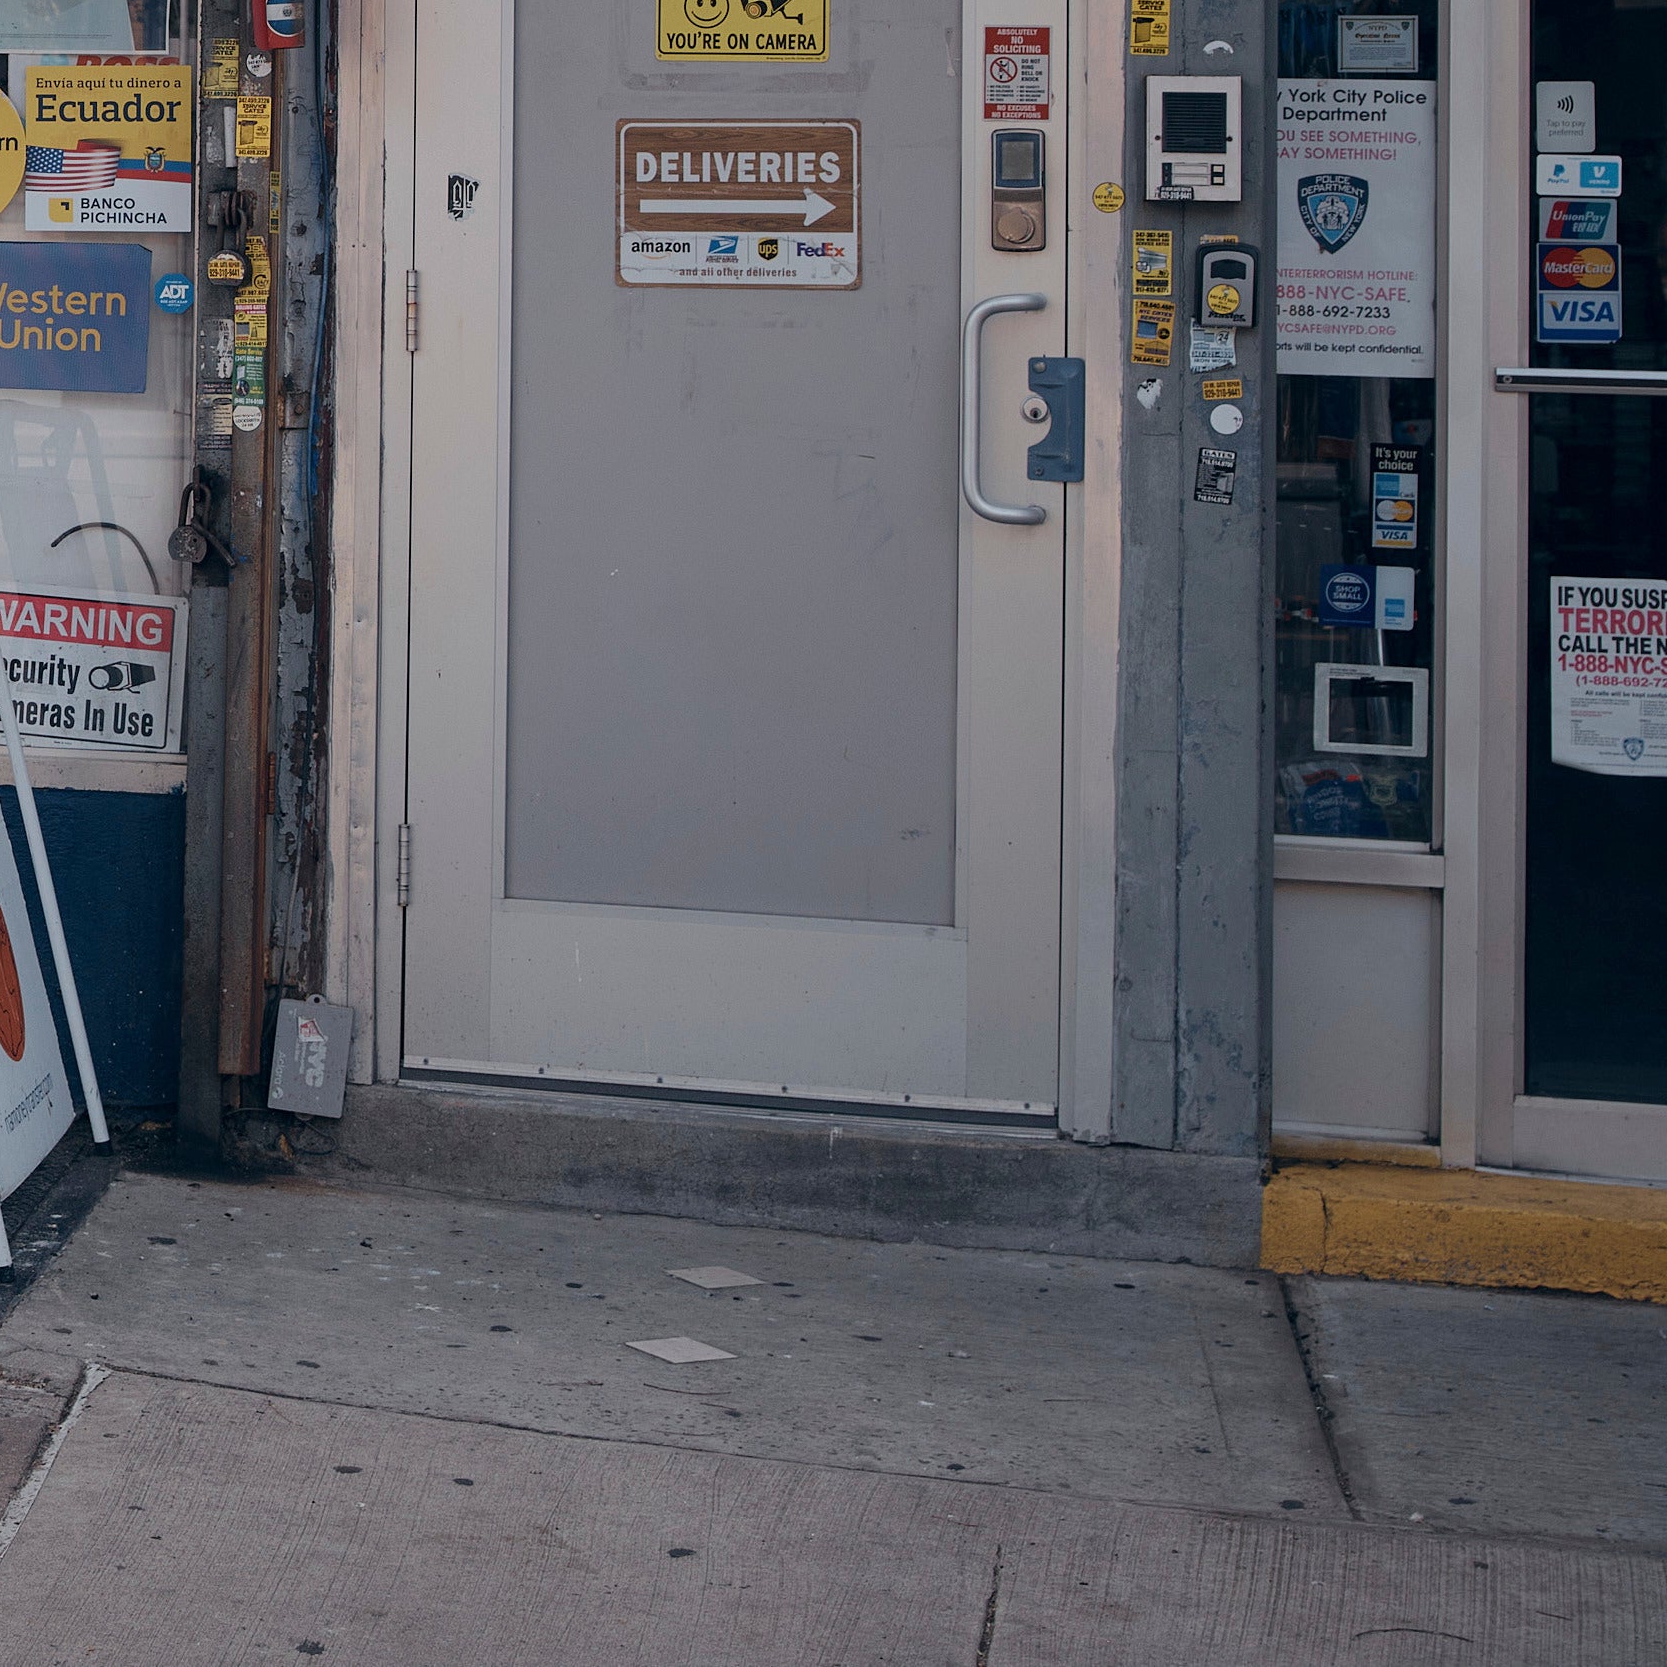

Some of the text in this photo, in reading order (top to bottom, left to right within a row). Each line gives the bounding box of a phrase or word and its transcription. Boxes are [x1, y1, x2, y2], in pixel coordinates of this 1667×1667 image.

[666, 32, 818, 52] YOU'RE ON CAMERA
[1010, 35, 1024, 44] NO
[993, 45, 1042, 54] SOLICITING
[35, 76, 183, 93] Envía aquí tu dinero a
[1288, 88, 1427, 106] York City Police
[36, 93, 181, 124] Ecuador
[1282, 106, 1388, 124] Department
[637, 152, 840, 183] DELIVERIES
[1315, 174, 1351, 185] POLICE
[1300, 183, 1365, 199] DEPARTMENT
[80, 197, 136, 211] BANCO
[80, 210, 168, 225] PICHINCHA
[1552, 210, 1606, 226] UnionPay
[630, 239, 691, 255] amazon
[796, 241, 846, 258] FedEx
[1544, 261, 1613, 276] MasterCard
[1546, 300, 1615, 323] VISA
[1375, 446, 1418, 461] It's your
[1378, 459, 1414, 472] choice
[1380, 530, 1409, 541] VISA
[1557, 585, 1667, 610] IF YOU SUSP
[1558, 634, 1653, 656] CALL THE
[84, 695, 106, 731] In
[112, 700, 155, 738] Use
